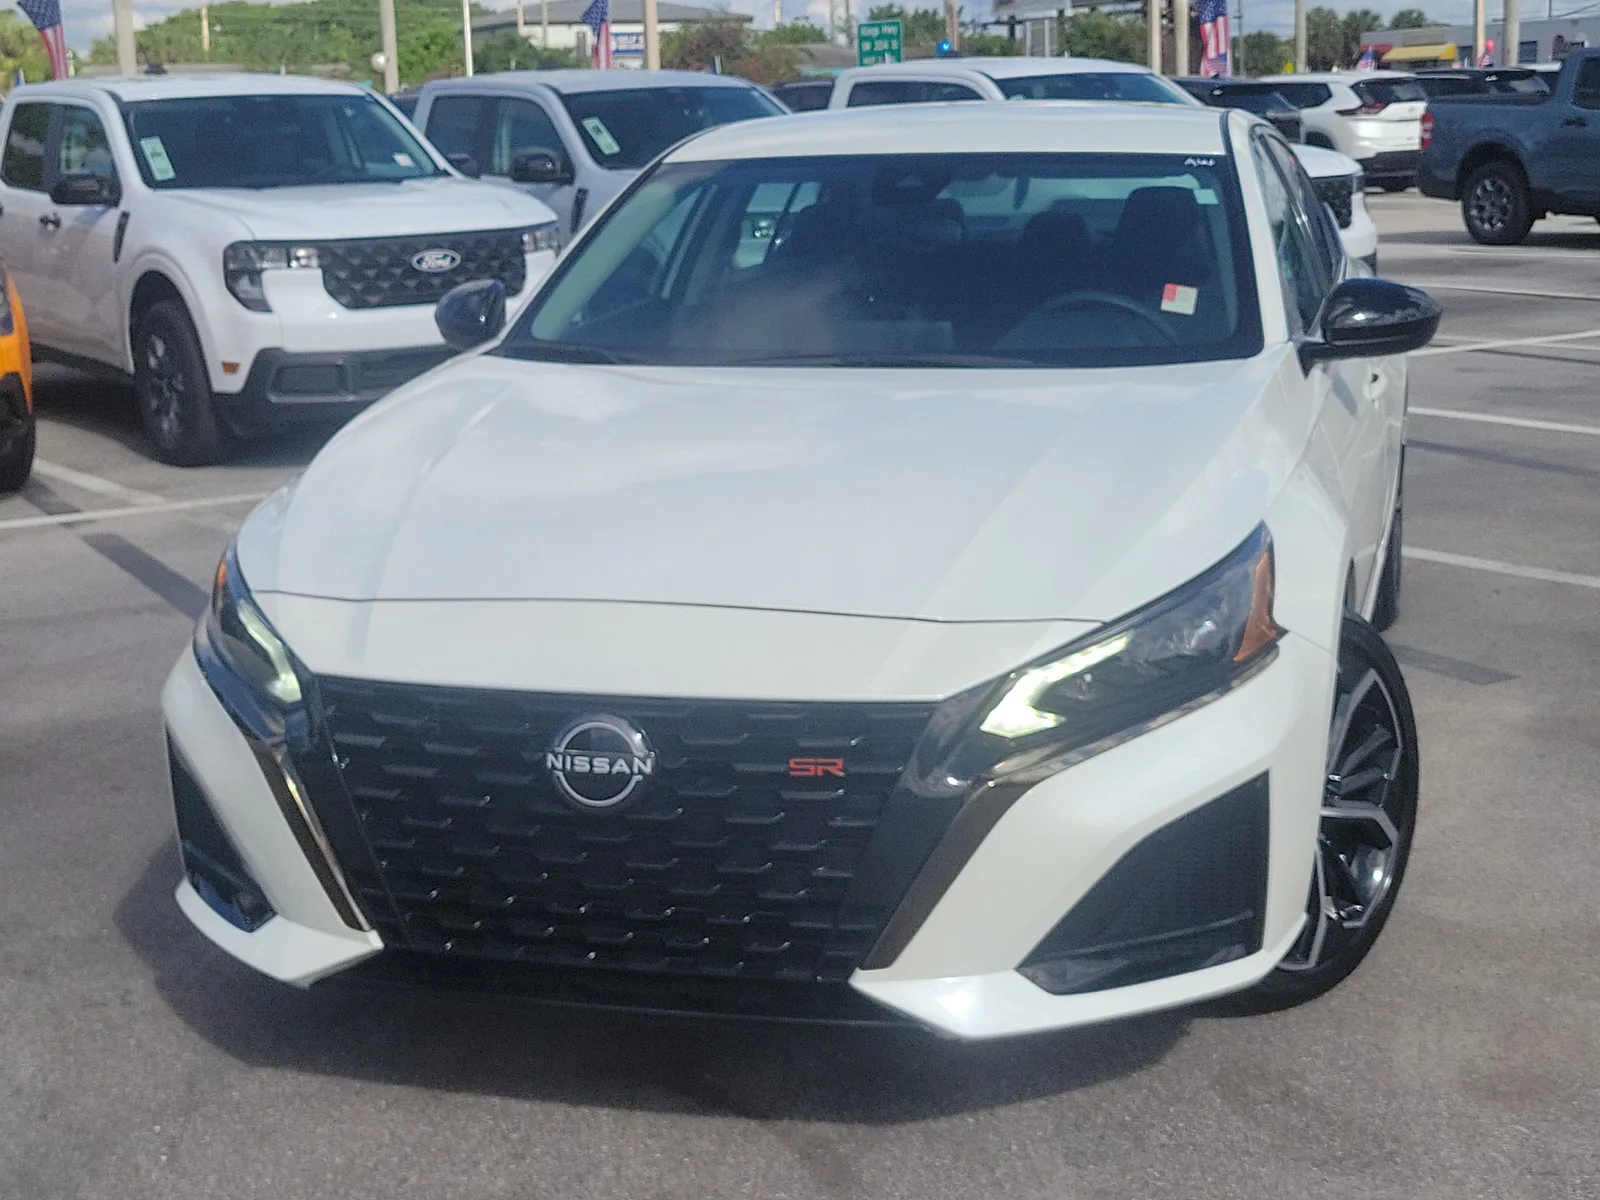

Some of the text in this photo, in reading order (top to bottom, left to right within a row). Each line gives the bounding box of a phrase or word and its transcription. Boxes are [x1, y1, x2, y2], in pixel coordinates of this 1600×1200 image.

[421, 253, 452, 270] Ford
[546, 752, 653, 775] NISSAN
[788, 758, 845, 777] SR
